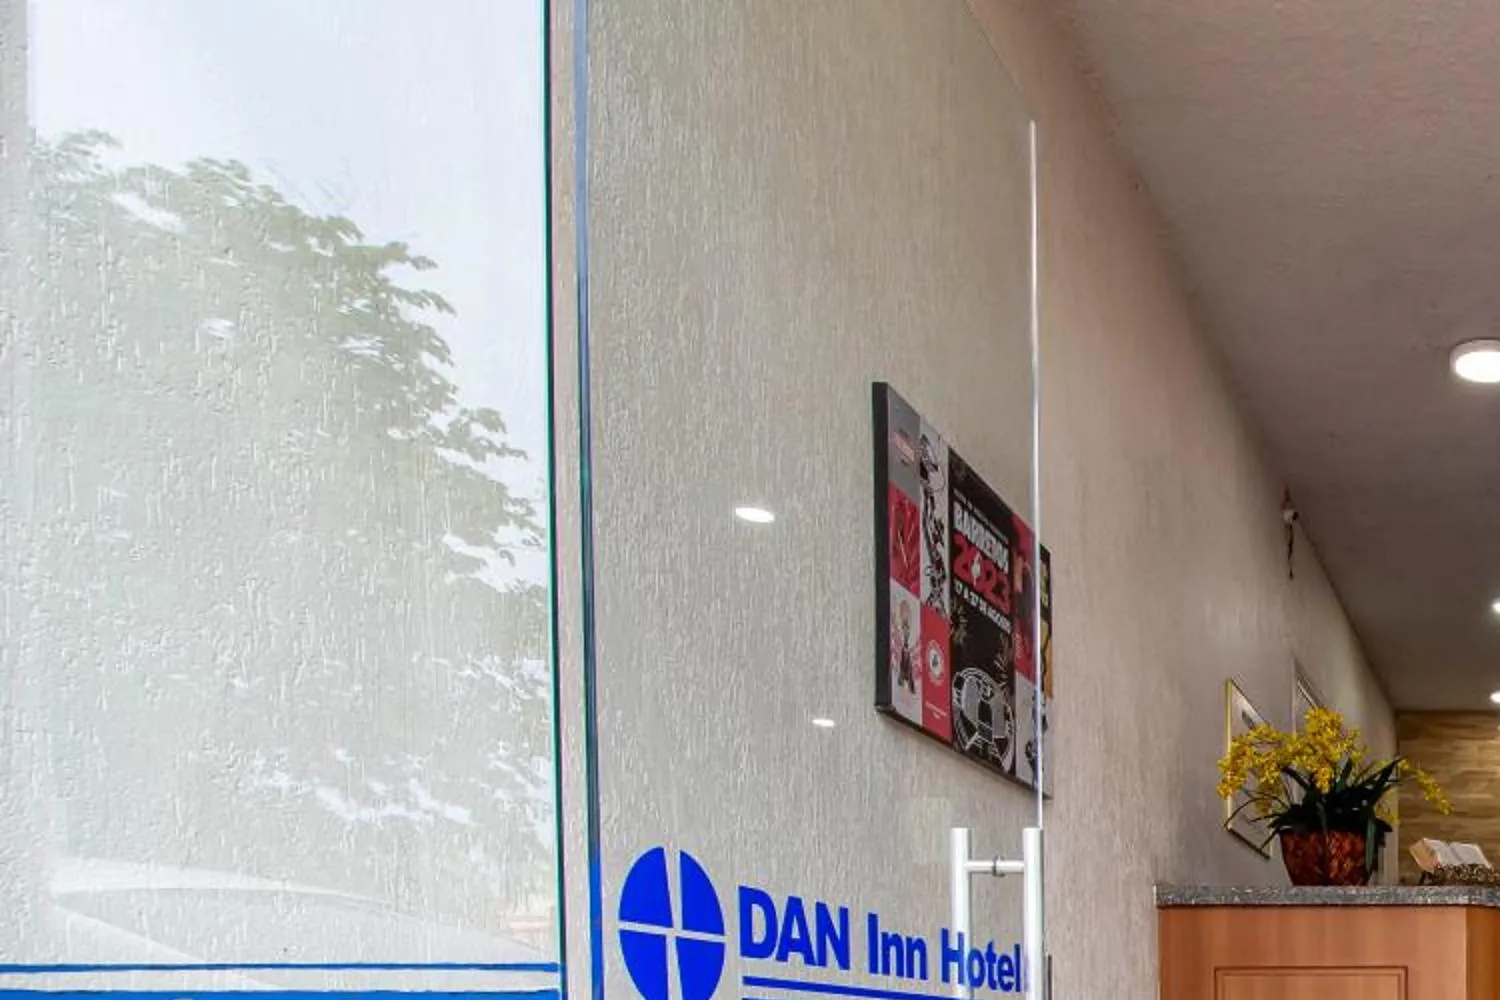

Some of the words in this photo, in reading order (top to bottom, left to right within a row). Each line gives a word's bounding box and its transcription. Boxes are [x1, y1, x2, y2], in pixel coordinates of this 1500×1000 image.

[738, 885, 850, 970] DAN
[867, 912, 928, 981] Inn
[941, 928, 1021, 993] Hotel
